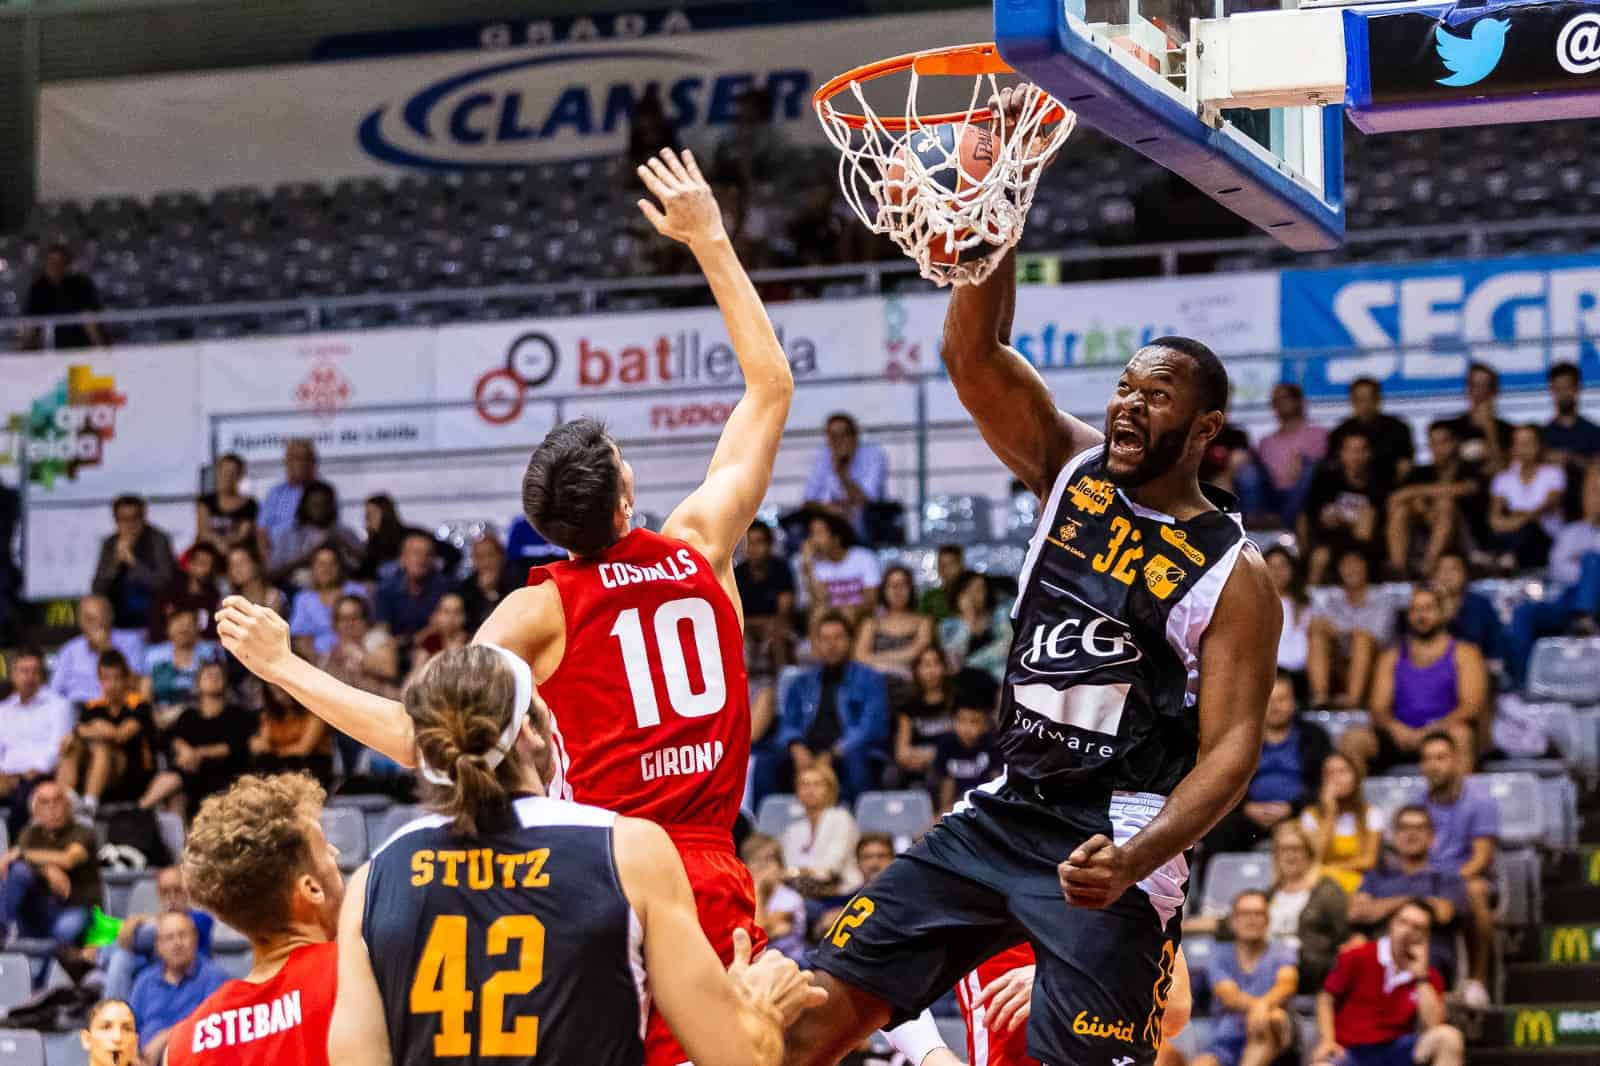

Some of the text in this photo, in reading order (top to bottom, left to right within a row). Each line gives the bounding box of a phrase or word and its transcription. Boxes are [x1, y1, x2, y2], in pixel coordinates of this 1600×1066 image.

[481, 10, 692, 48] GRADA
[449, 70, 813, 144] CLANSER
[1091, 516, 1144, 586] 32
[610, 597, 727, 729] 10
[1029, 617, 1125, 664] ICG
[640, 740, 724, 782] GIRONA
[410, 847, 550, 890] STUTZ
[409, 914, 546, 1057] 42
[192, 990, 302, 1053] ESTEBAN
